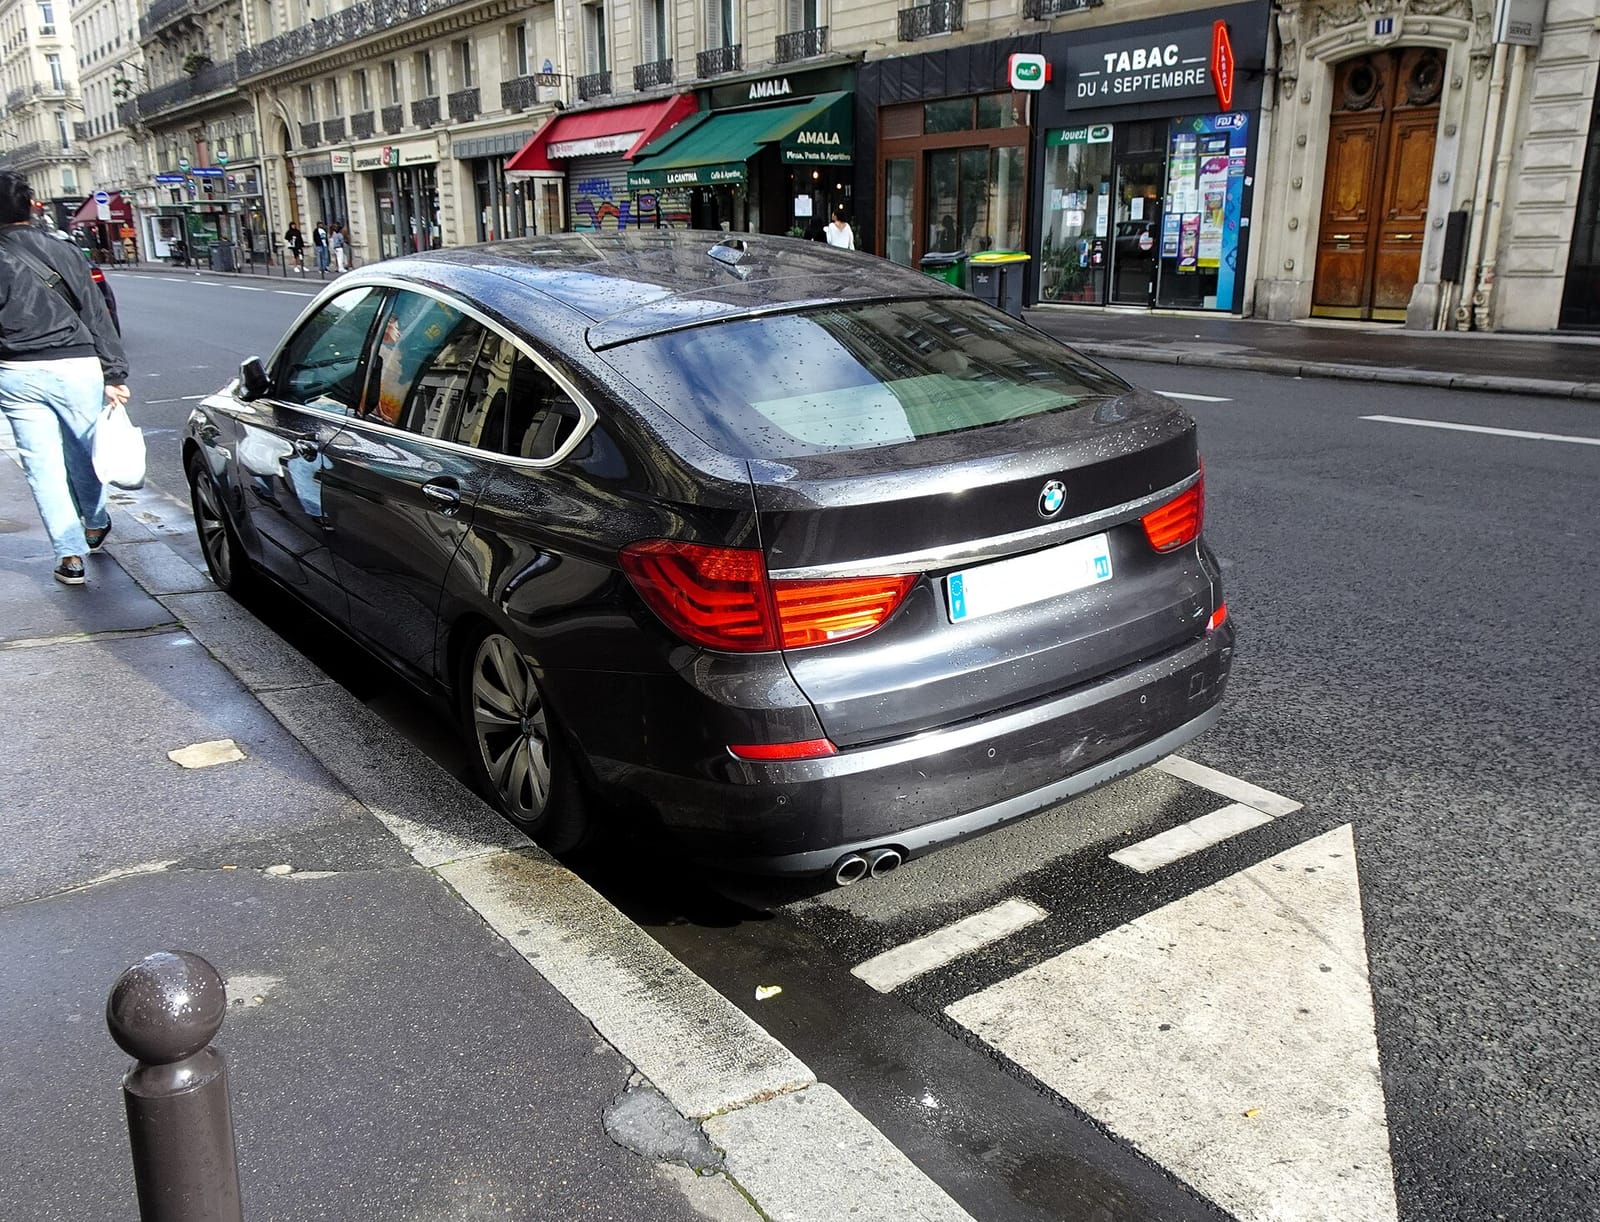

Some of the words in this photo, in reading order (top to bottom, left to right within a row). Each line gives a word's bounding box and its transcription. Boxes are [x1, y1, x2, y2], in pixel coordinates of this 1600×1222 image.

[1104, 44, 1179, 73] TABAC
[749, 78, 790, 99] AMALA
[1077, 81, 1097, 97] DU
[1100, 80, 1109, 94] 4
[1113, 68, 1206, 93] SEPTEMBRE
[1217, 116, 1232, 126] FDJ
[797, 131, 840, 145] AMALA
[1061, 129, 1088, 141] Jouez!
[667, 174, 675, 183] LA
[675, 172, 698, 183] CANTINA
